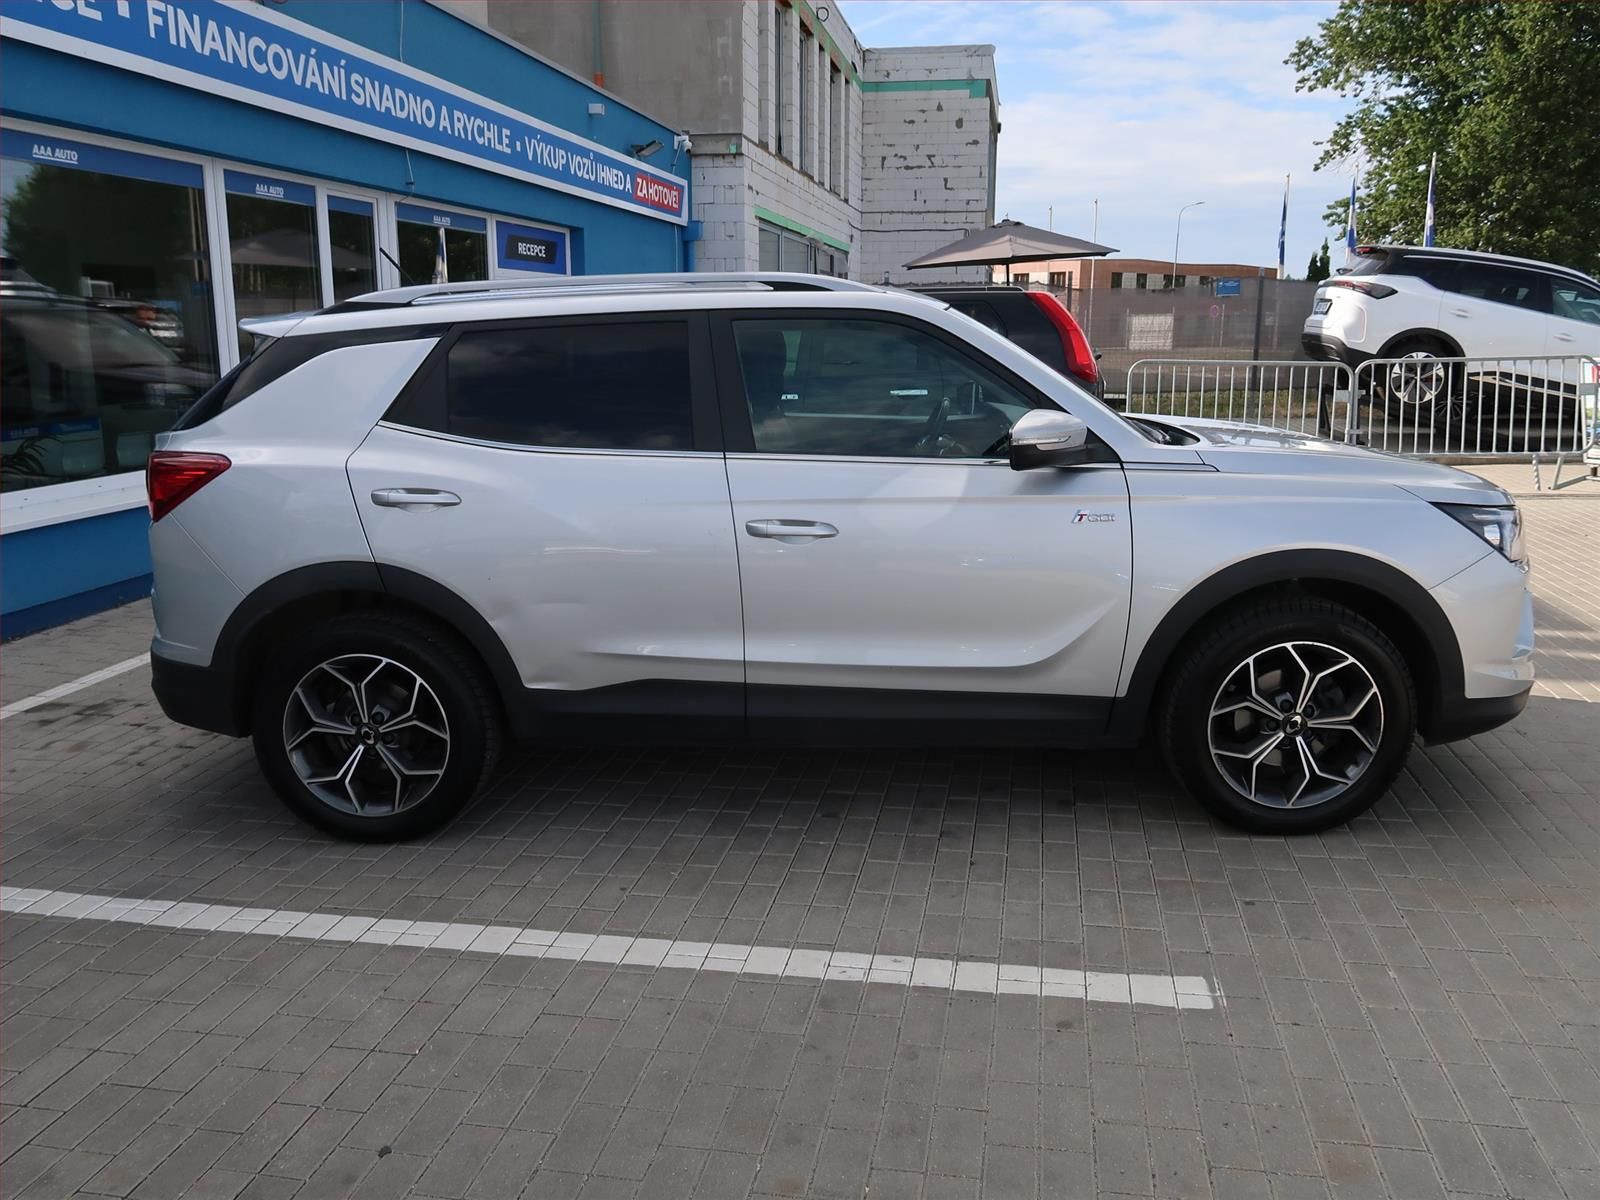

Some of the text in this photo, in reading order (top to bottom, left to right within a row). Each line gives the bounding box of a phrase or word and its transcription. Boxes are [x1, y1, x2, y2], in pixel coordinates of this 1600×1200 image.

[147, 0, 347, 100] FINANCOVÁNÍ
[350, 72, 436, 128] SNADNO
[439, 105, 452, 135] A
[453, 109, 511, 154] RYCHLE
[524, 134, 567, 171] VÝKUP
[567, 152, 596, 182] VOZŮ
[596, 163, 625, 190] IHNED
[625, 173, 632, 193] A
[636, 177, 648, 199] ZA
[32, 143, 78, 161] AAA AUTO
[255, 183, 284, 196] AAA AUTO
[518, 242, 546, 258] RECEPCE
